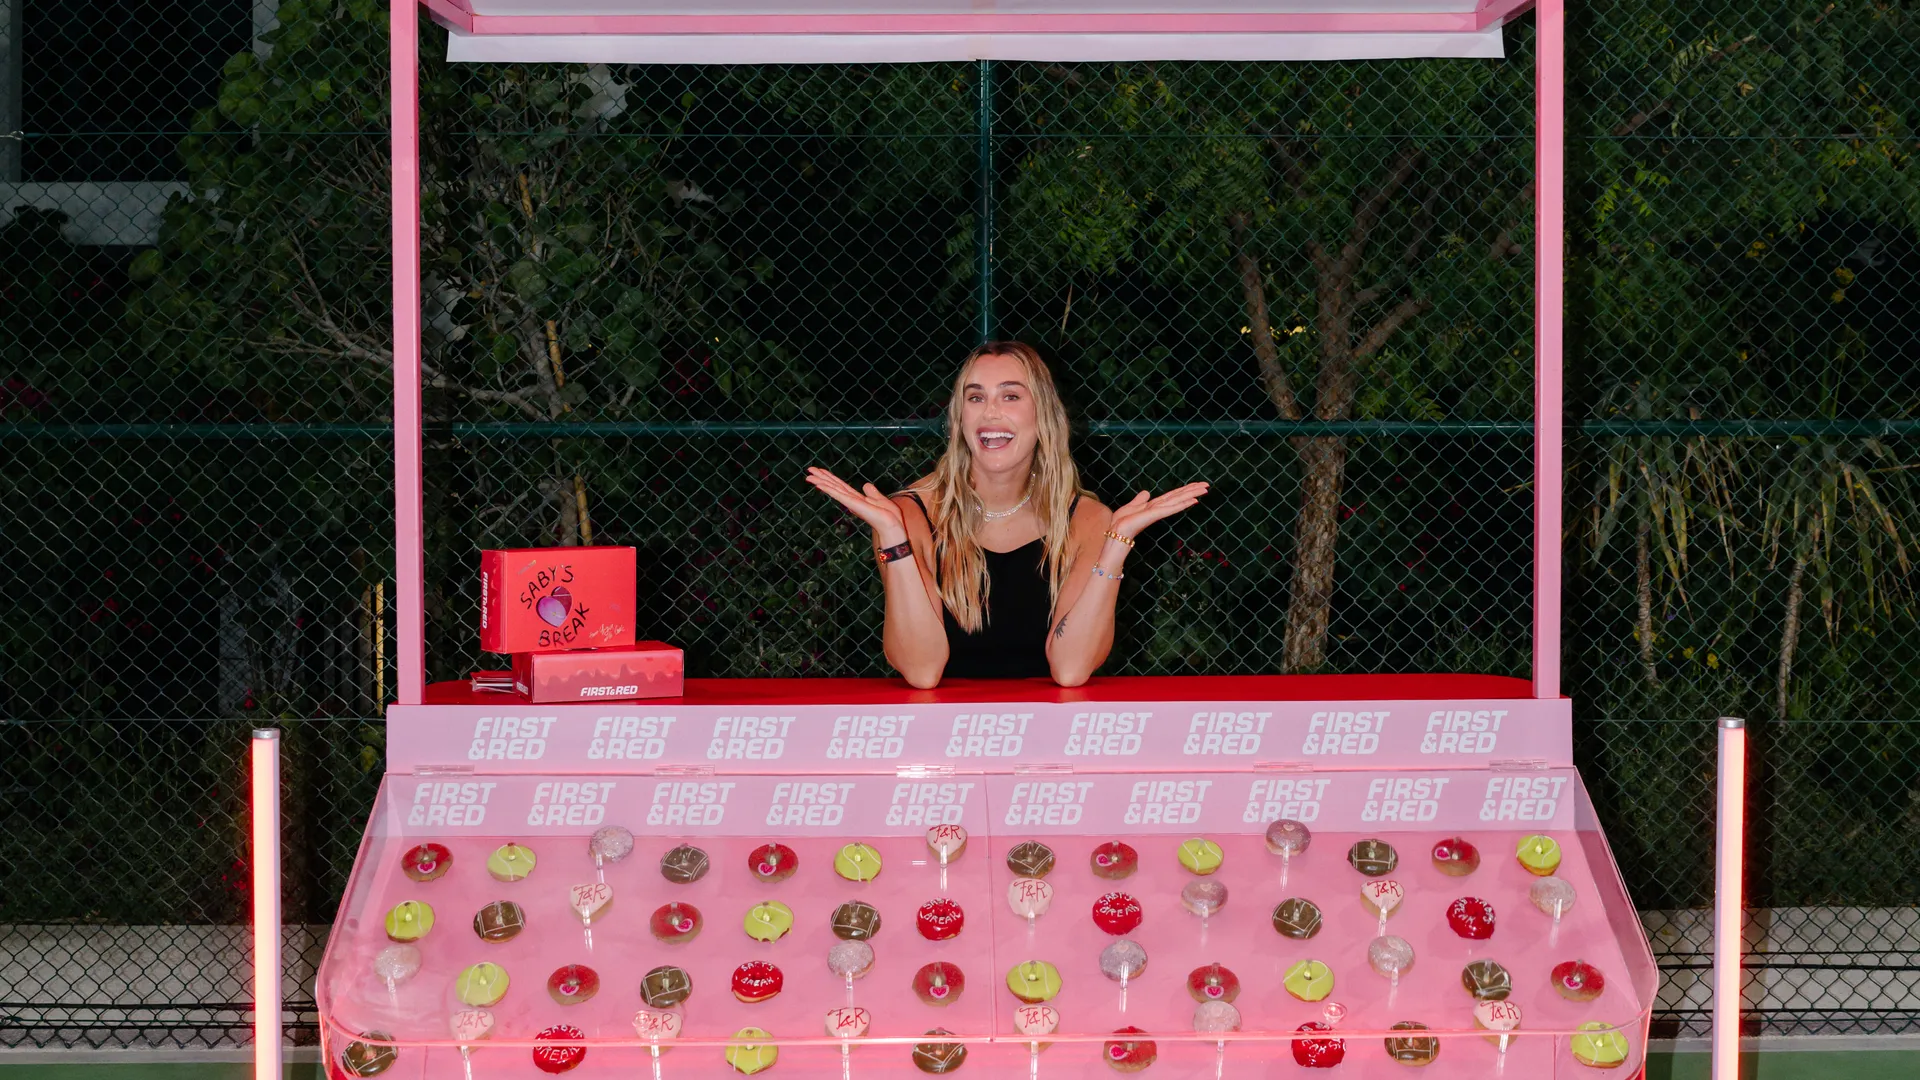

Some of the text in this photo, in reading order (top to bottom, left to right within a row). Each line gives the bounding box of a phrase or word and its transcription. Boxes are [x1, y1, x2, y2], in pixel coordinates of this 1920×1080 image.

[538, 602, 590, 647] BREAK
[580, 685, 638, 697] FIRST&RED
[474, 717, 557, 738] FIRST
[594, 717, 676, 737] FIRST
[713, 717, 796, 737] FIRST
[833, 715, 915, 736] FIRST
[952, 714, 1033, 735] FIRST
[1070, 713, 1152, 733] FIRST
[1189, 712, 1272, 733] FIRST
[1309, 712, 1390, 733] FIRST
[1426, 711, 1508, 731] FIRST
[468, 739, 545, 760] &RED
[588, 738, 665, 759] &RED
[707, 738, 784, 759] &RED
[826, 737, 904, 759] &RED
[945, 736, 1023, 757] &RED
[1064, 734, 1141, 755] &RED
[1184, 734, 1260, 754] &RED
[1303, 734, 1379, 754] &RED
[1420, 732, 1496, 753] &RED
[414, 783, 496, 804] FIRST
[534, 782, 616, 803] FIRST
[653, 783, 735, 803] FIRST
[772, 783, 855, 804] FIRST
[892, 783, 974, 804] FIRST
[1012, 782, 1094, 803] FIRST
[1130, 781, 1212, 802] FIRST
[1249, 779, 1331, 800] FIRST
[1368, 778, 1449, 799] FIRST
[1486, 777, 1567, 798] FIRST
[408, 805, 485, 826] &RED
[528, 804, 604, 825] &RED
[647, 803, 724, 825] &RED
[766, 805, 843, 825] &RED
[886, 805, 963, 826] &RED
[1005, 804, 1082, 825] &RED
[1124, 803, 1201, 824] &RED
[1243, 800, 1320, 822] &RED
[1361, 800, 1438, 821] &RED
[1480, 798, 1556, 821] &RED
